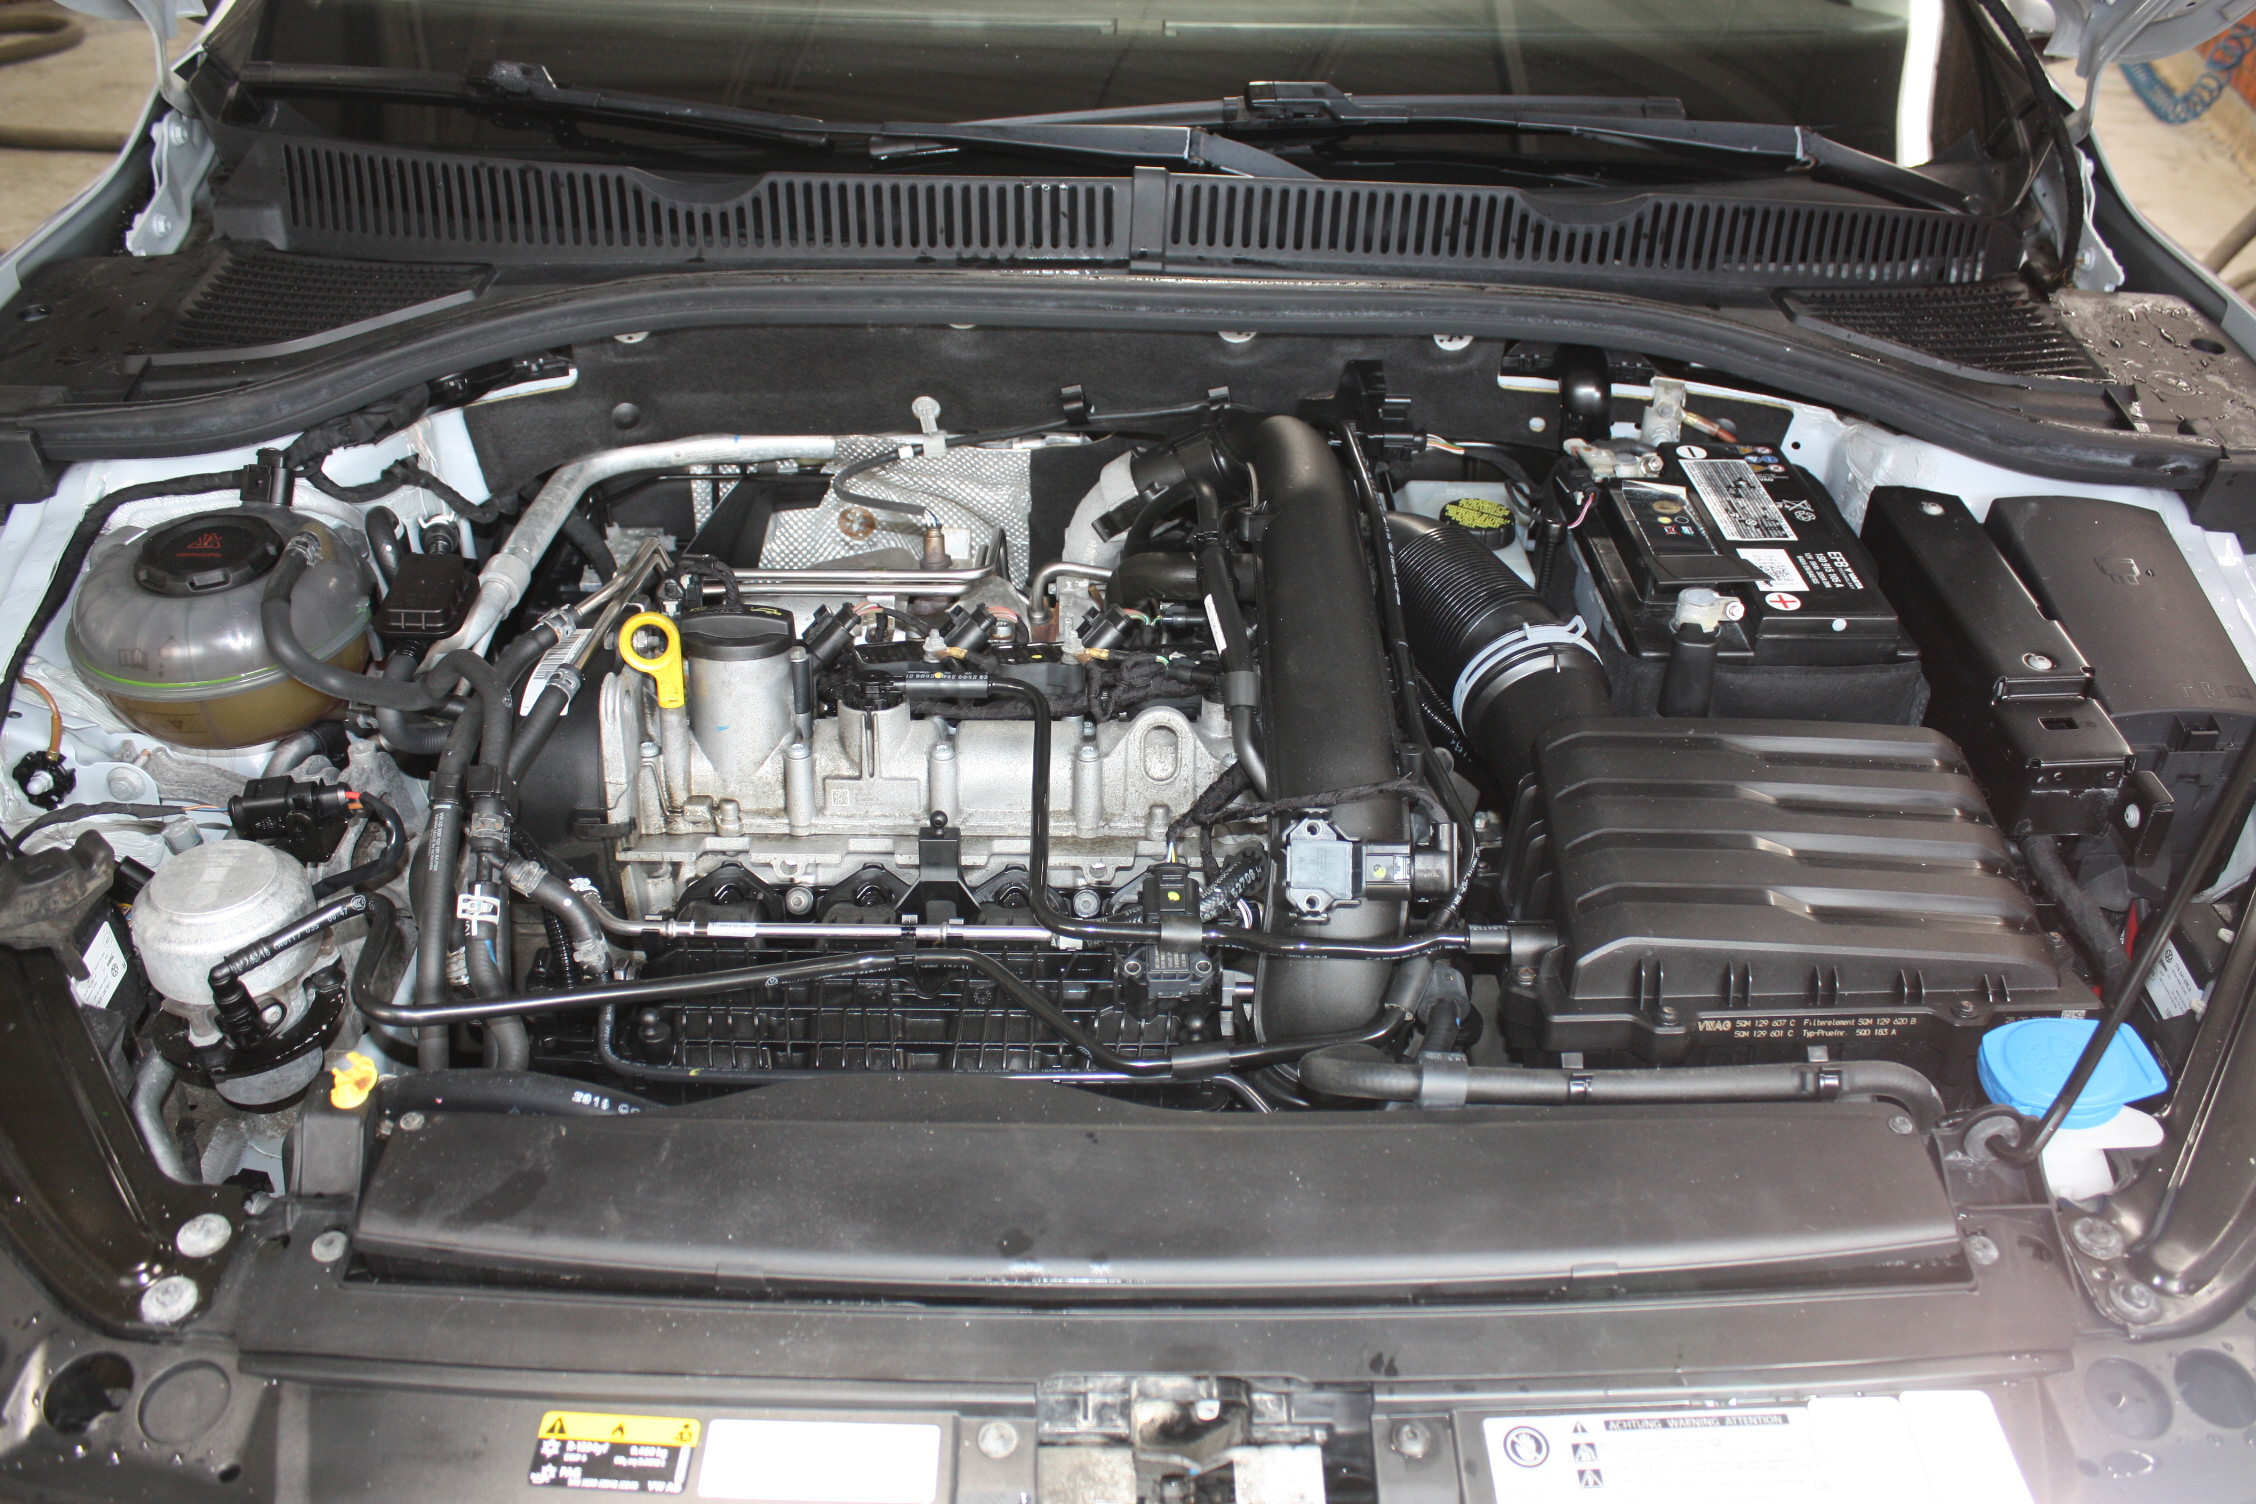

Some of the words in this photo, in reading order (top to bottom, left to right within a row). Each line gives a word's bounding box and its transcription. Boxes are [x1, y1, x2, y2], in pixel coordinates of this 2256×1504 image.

[1827, 552, 1849, 567] EFB
[1698, 1021, 1731, 1031] VWAG
[1803, 1018, 1855, 1026] Filterelement
[1876, 1018, 1890, 1026] 129
[1893, 1017, 1908, 1025] 620
[1910, 1017, 1917, 1025] B
[1753, 1030, 1767, 1038] 129
[1788, 1029, 1794, 1037] C
[1890, 1028, 1897, 1036] A
[1608, 1419, 1662, 1431] ACHTUNG
[1666, 1417, 1720, 1429] WARNING
[1725, 1414, 1784, 1427] ATTENTION
[647, 1480, 666, 1492] VW
